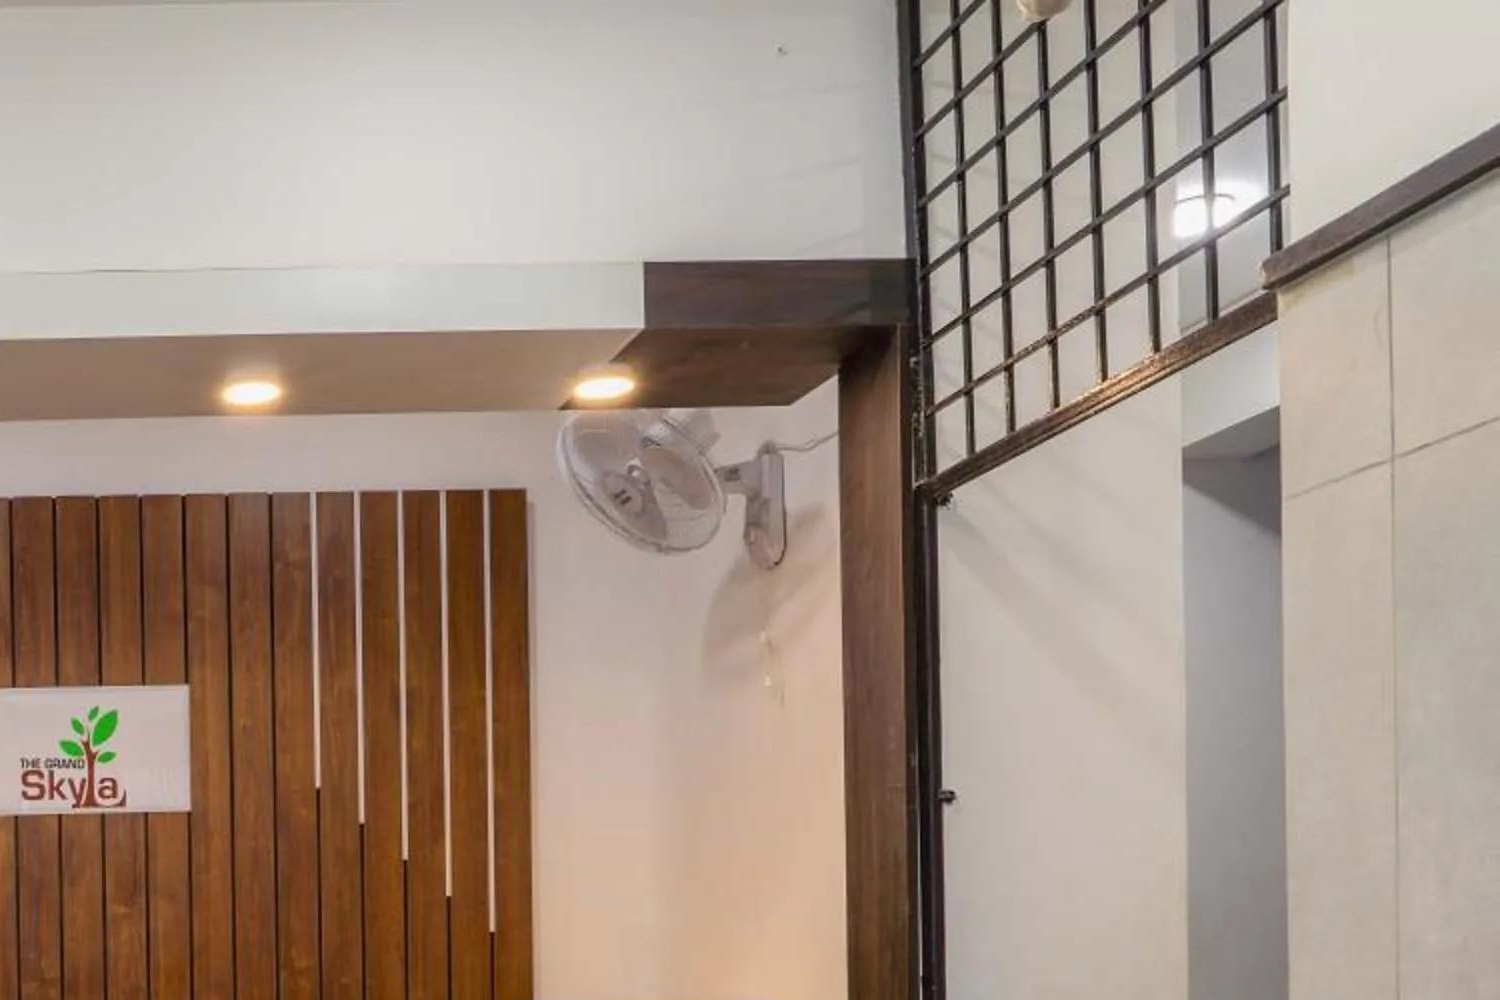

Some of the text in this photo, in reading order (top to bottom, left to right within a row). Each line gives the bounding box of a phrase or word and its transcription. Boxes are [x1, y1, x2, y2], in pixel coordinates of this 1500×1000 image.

[20, 757, 85, 769] THE GRAND
[21, 769, 125, 808] Skyla
